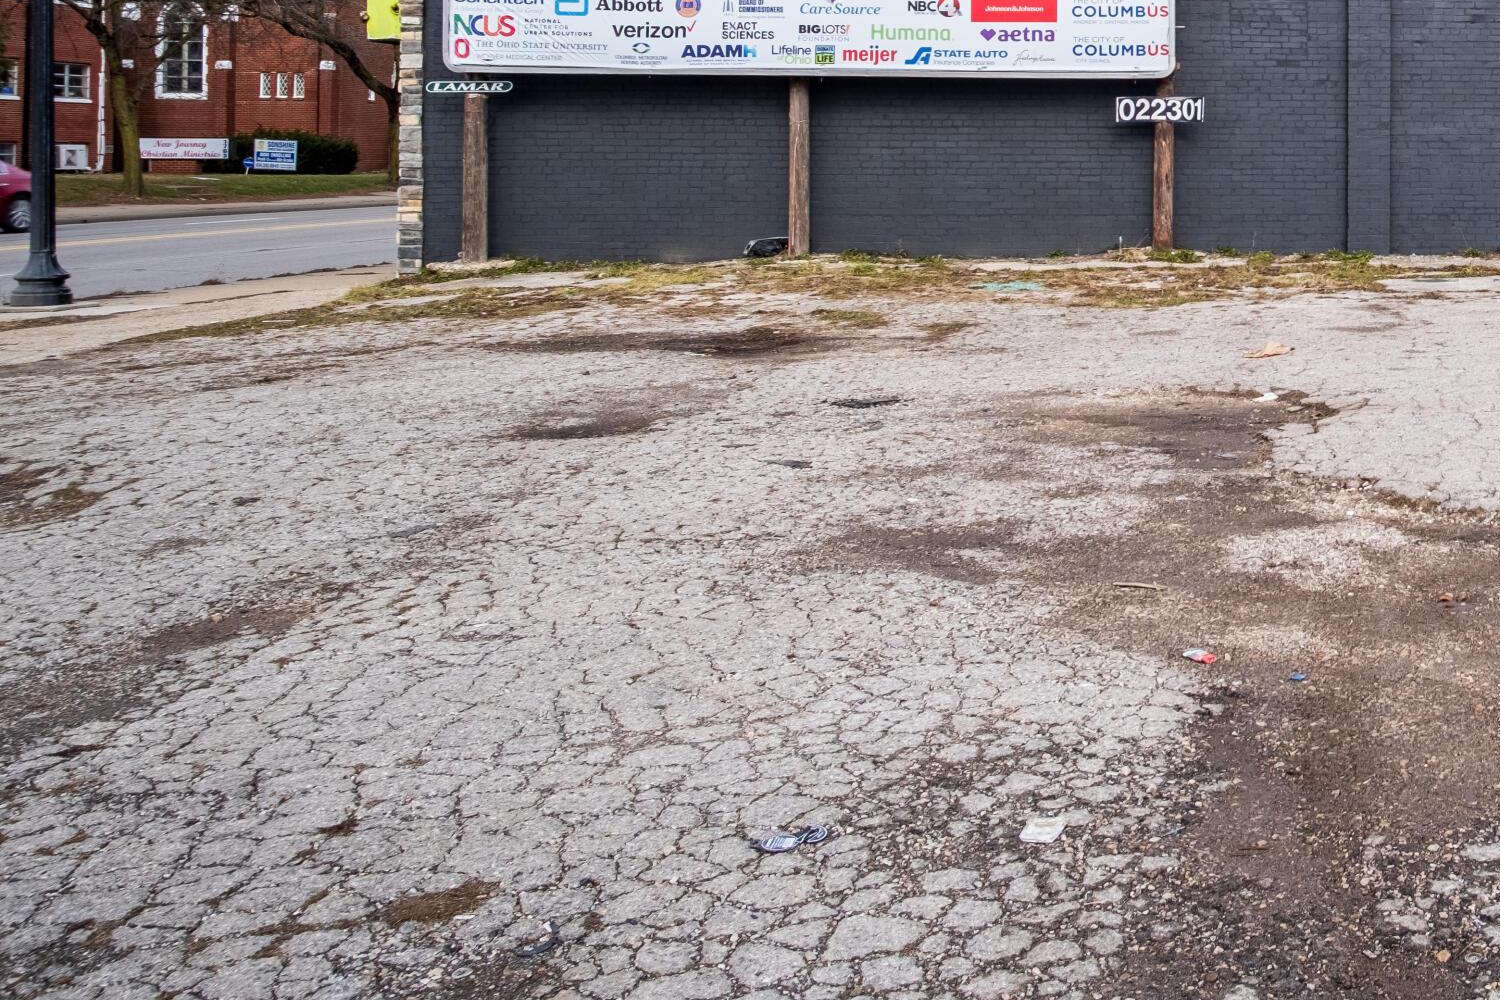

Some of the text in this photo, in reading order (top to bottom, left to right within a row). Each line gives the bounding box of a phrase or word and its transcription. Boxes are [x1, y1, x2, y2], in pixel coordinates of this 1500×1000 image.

[800, 2, 881, 15] CareSource
[908, 1, 937, 11] NBC
[1072, 5, 1169, 17] COLUMBUS
[453, 13, 516, 37] NCUS
[613, 22, 687, 38] verizon
[722, 22, 757, 30] EXACT
[722, 31, 774, 40] SCIENCES
[998, 27, 1056, 42] aetna
[681, 44, 757, 58] ADAMH
[771, 45, 812, 55] Lifeline
[843, 45, 898, 65] meijer
[934, 50, 971, 58] STATE
[974, 50, 1009, 59] AUTO
[1073, 44, 1169, 56] COLUMBUS
[785, 55, 812, 64] Ohio
[817, 55, 834, 63] LIFE
[433, 82, 504, 91] LAMAR
[1119, 98, 1202, 121] 022301
[153, 140, 207, 149] New Journey
[180, 150, 221, 158] Ministries
